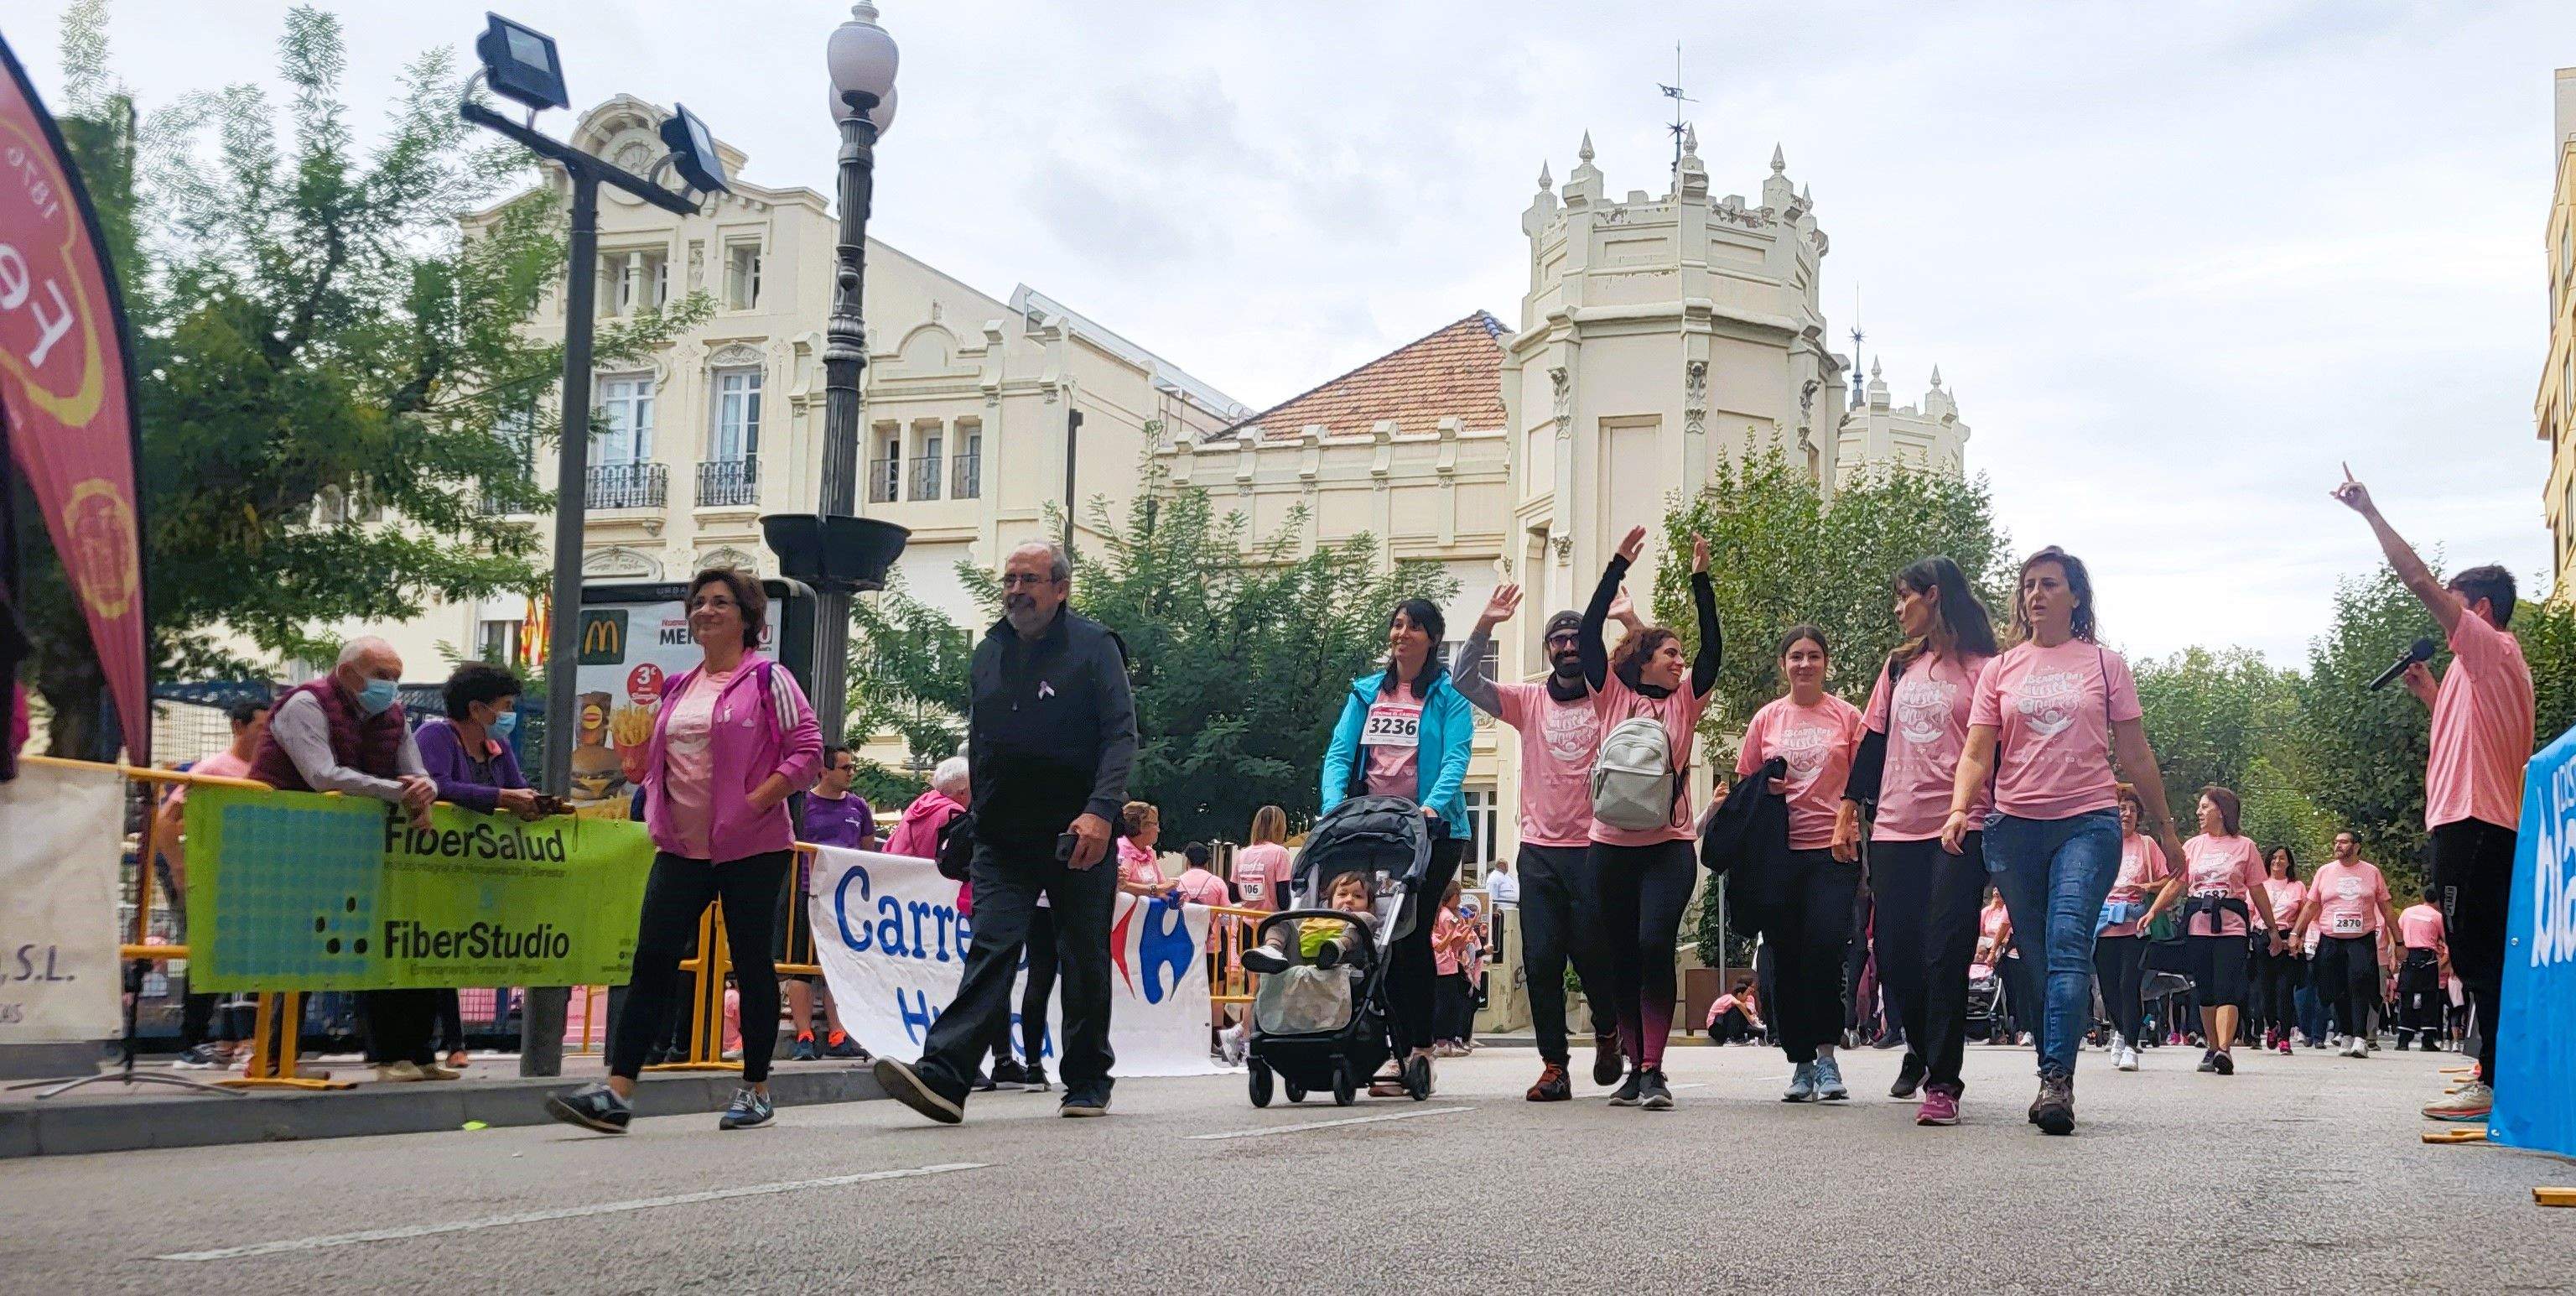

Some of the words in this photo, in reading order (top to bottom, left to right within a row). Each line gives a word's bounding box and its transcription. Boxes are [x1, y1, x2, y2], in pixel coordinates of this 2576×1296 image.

[1368, 718, 1417, 736] 3236
[385, 814, 566, 862] FiberSalud
[1244, 884, 1259, 894] 106
[2335, 919, 2361, 928] 2870
[384, 921, 569, 959] FiberStudio
[13, 944, 75, 981] S.L.
